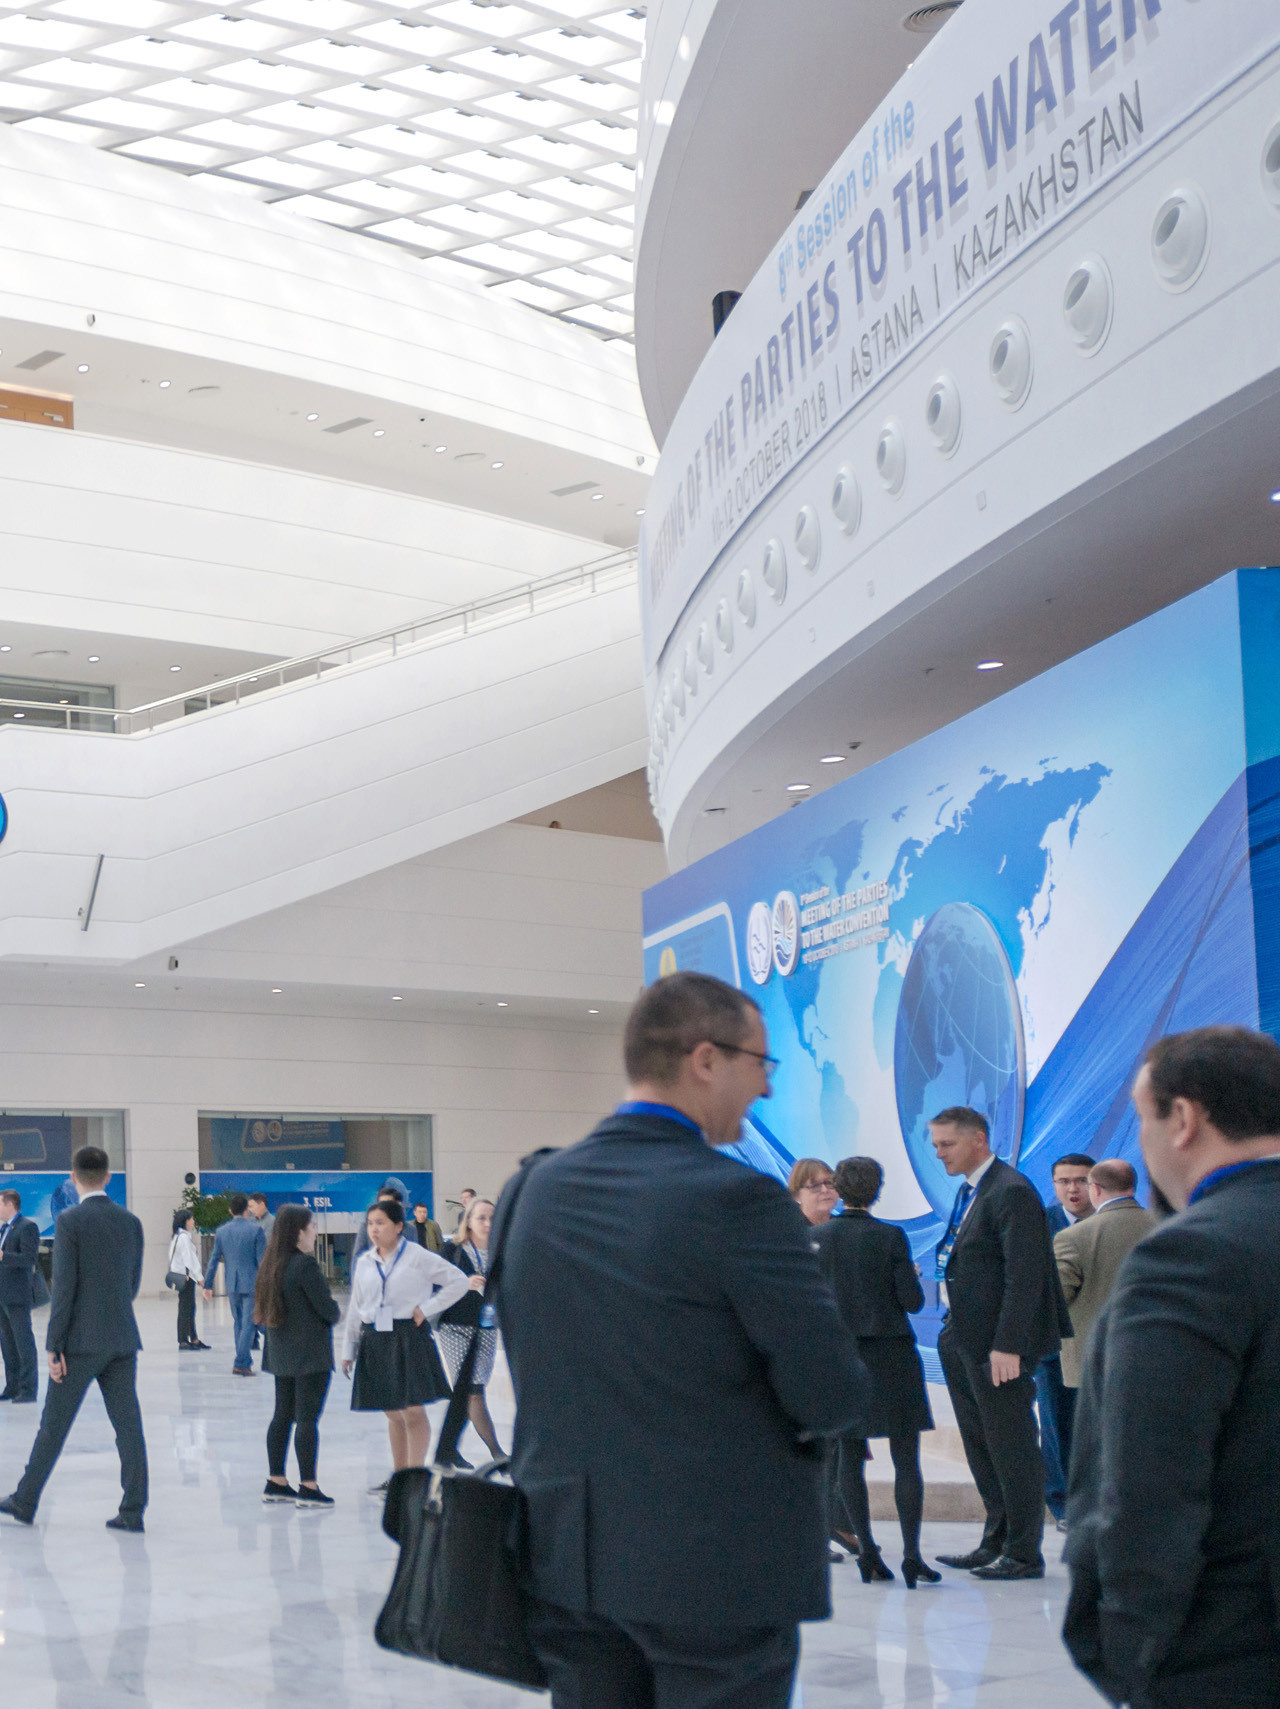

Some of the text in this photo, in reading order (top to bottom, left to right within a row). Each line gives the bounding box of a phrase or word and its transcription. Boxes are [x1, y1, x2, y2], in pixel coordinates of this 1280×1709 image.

[797, 170, 857, 270] Session
[862, 126, 879, 187] of
[884, 100, 914, 161] the
[687, 448, 702, 520] OF
[705, 394, 736, 489] THE
[741, 260, 839, 438] PARTIES
[847, 208, 887, 305] TO
[893, 114, 968, 254] THE
[735, 420, 792, 513] OCTOBER
[795, 380, 827, 448] 2018
[851, 285, 924, 392] ASTANA
[953, 79, 1144, 290] KAZAKHSTAN
[857, 880, 889, 906] PARTIES
[314, 1197, 332, 1207] ESIL
